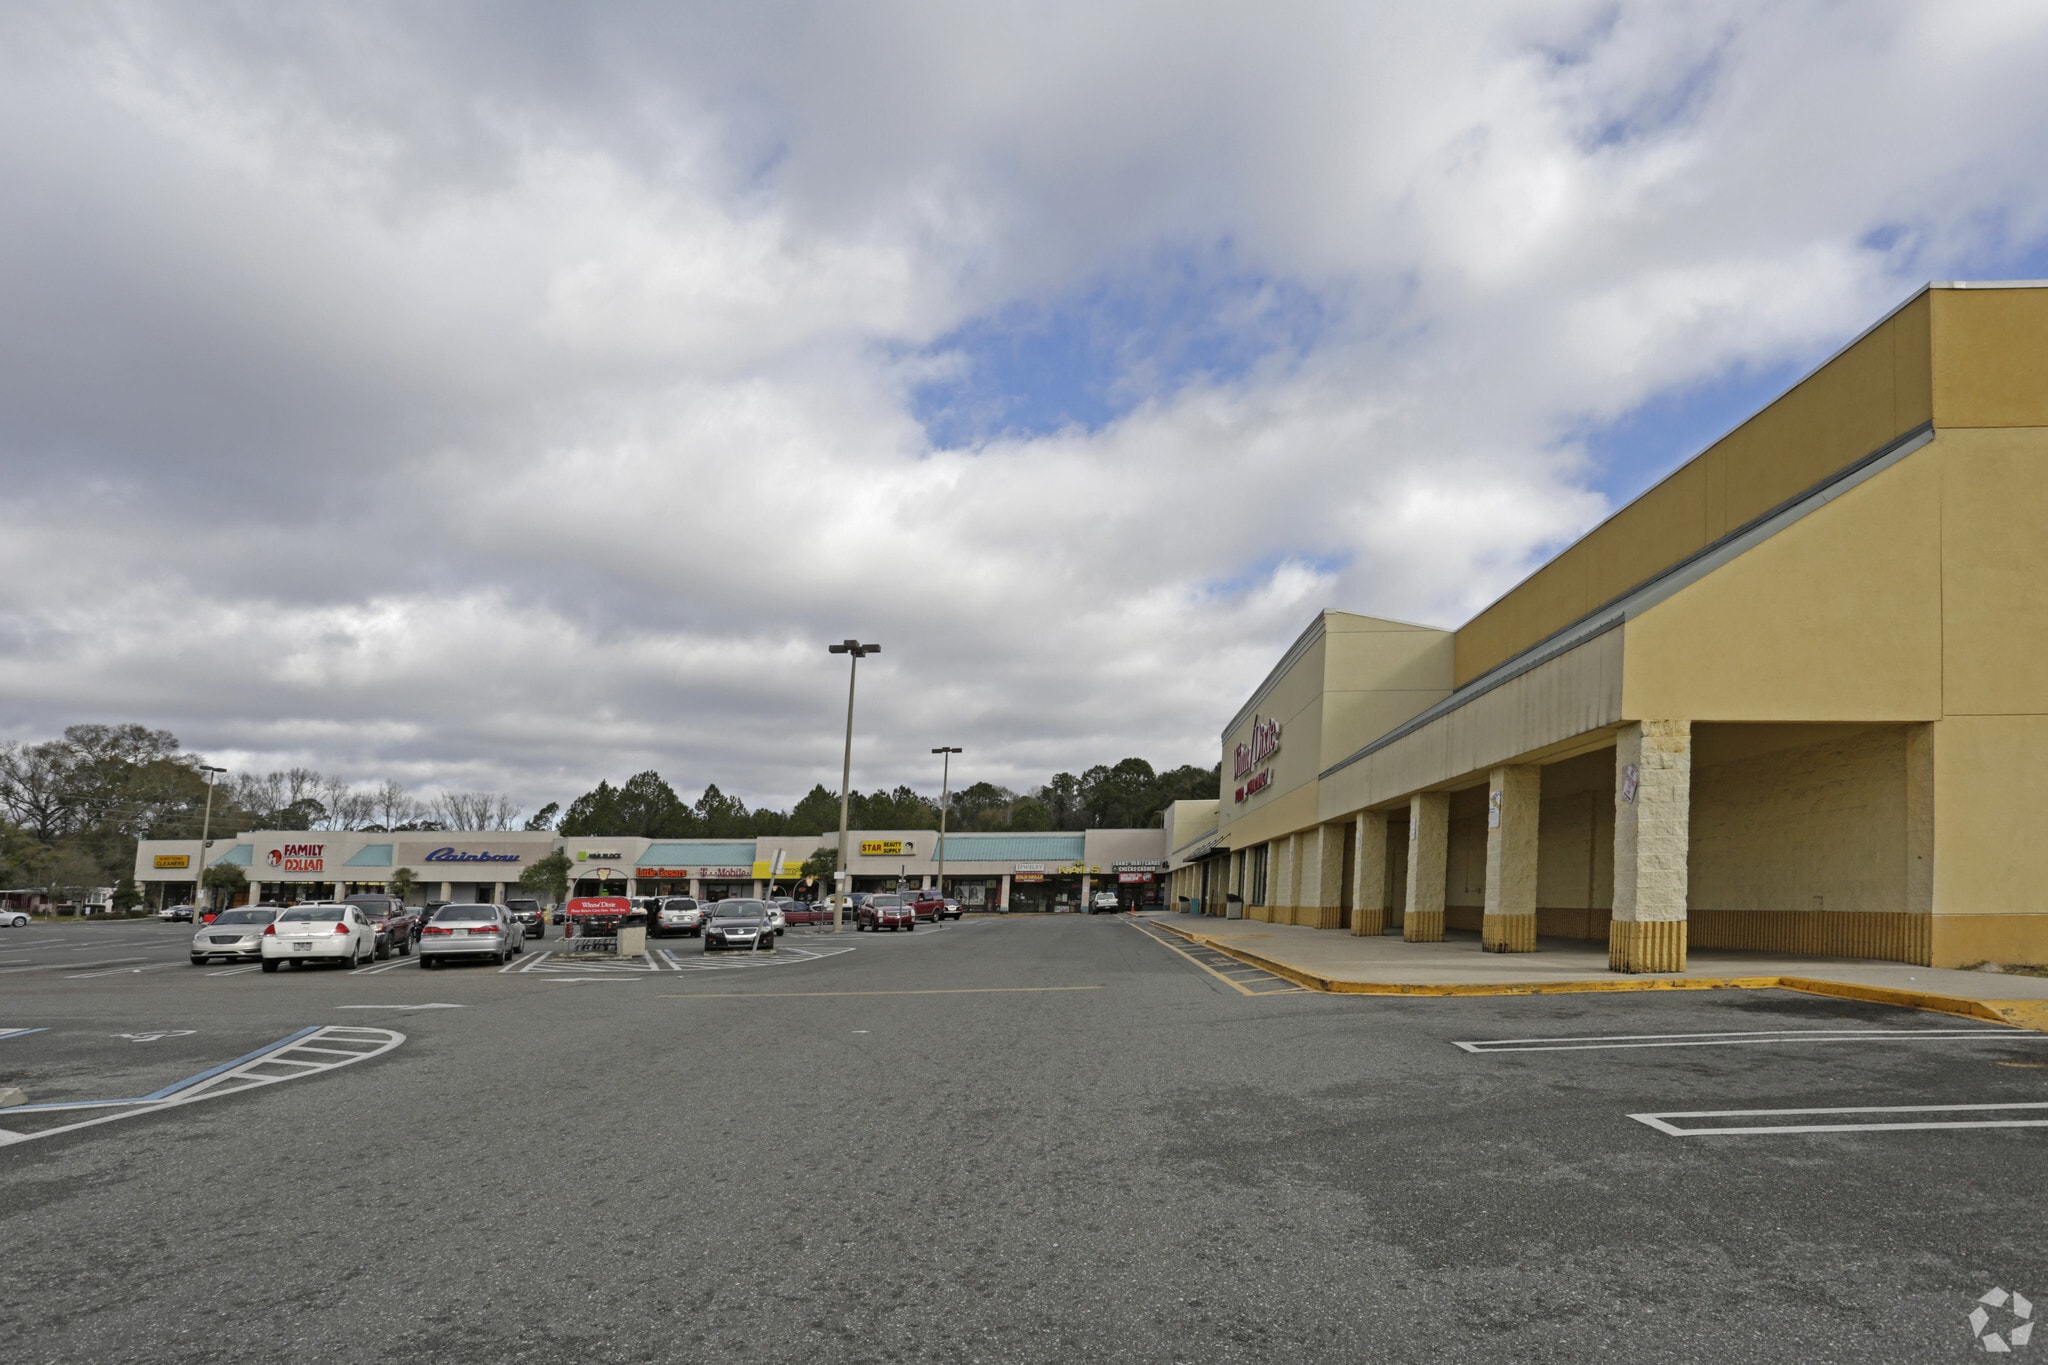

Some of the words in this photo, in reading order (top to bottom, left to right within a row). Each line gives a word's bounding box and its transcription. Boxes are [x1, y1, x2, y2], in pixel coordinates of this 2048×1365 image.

[284, 844, 324, 856] FAMILY
[425, 847, 520, 862] Rainbow
[284, 858, 324, 871] DOLLAR
[1058, 866, 1100, 874] NAILS
[636, 867, 657, 877] Little
[658, 868, 687, 877] Caesars
